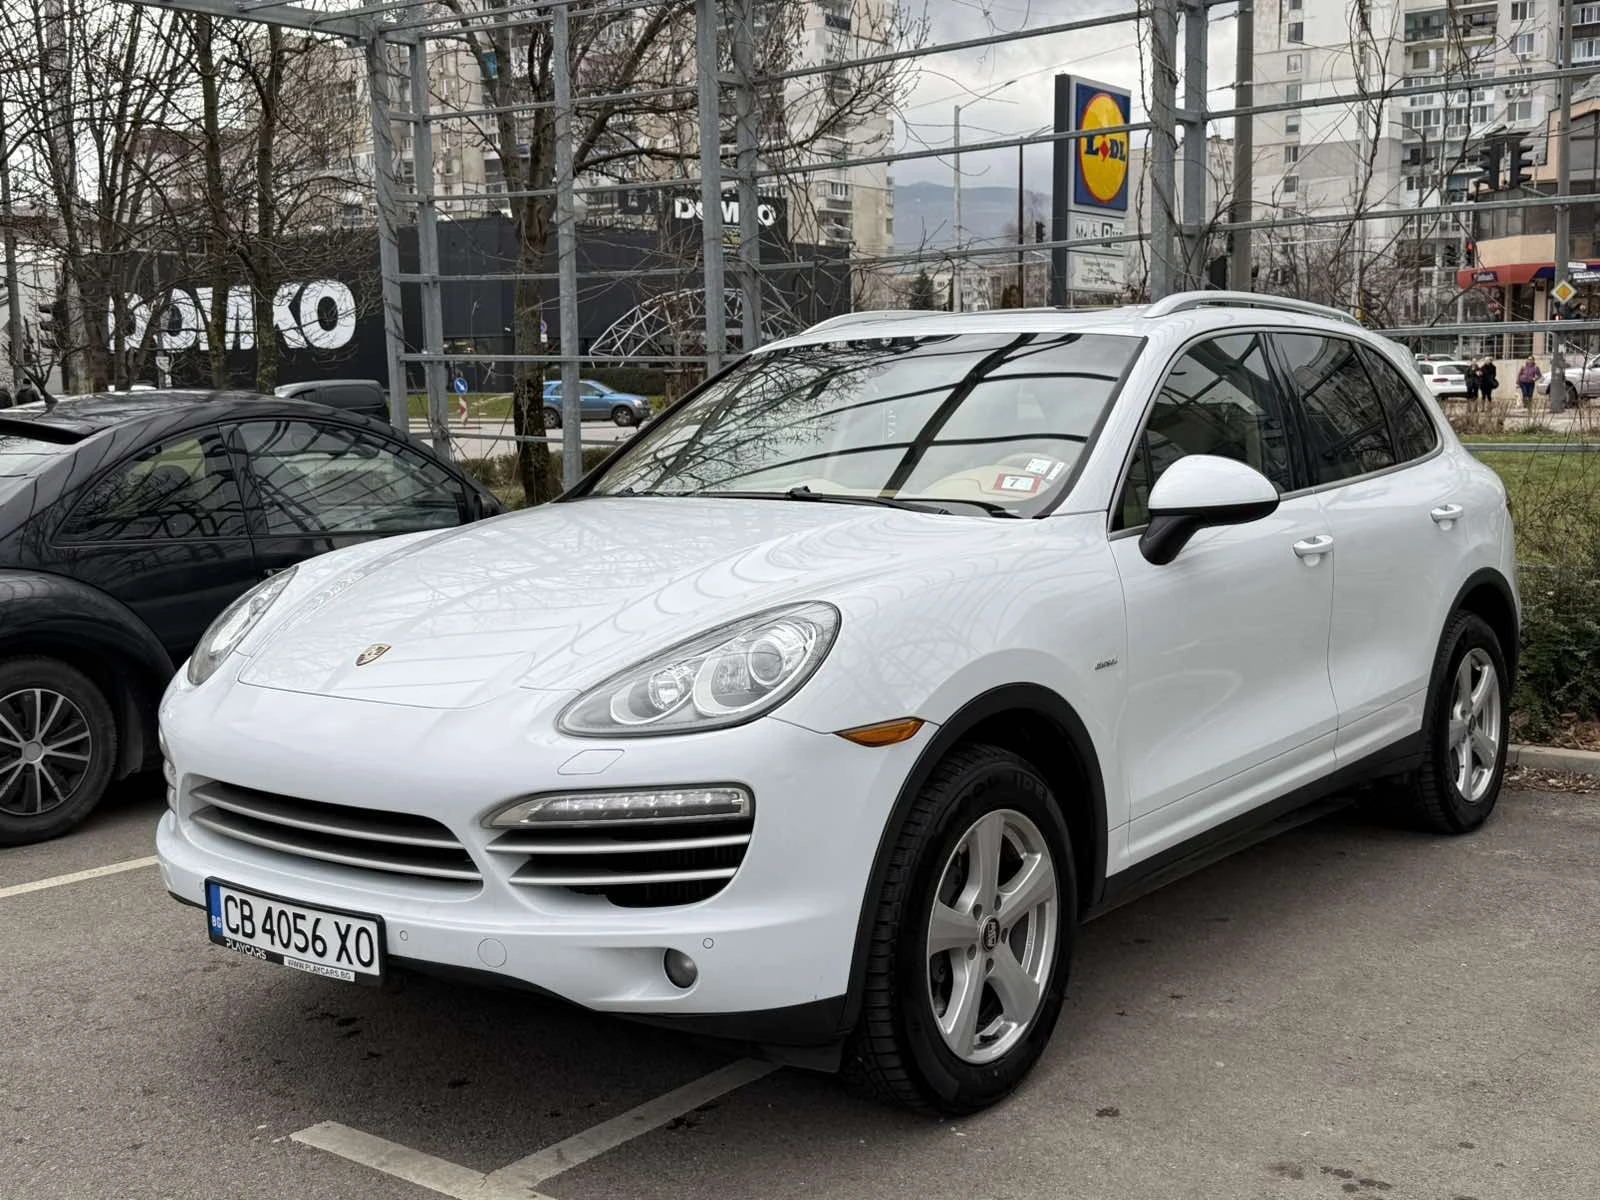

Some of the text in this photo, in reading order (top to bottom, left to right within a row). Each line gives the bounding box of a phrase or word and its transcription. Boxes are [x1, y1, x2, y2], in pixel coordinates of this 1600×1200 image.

[211, 915, 222, 929] BG
[224, 894, 374, 967] CB 4056 XO
[226, 939, 267, 960] PLAYCARS
[288, 959, 352, 980] WWW.PLAYCARS.BG
